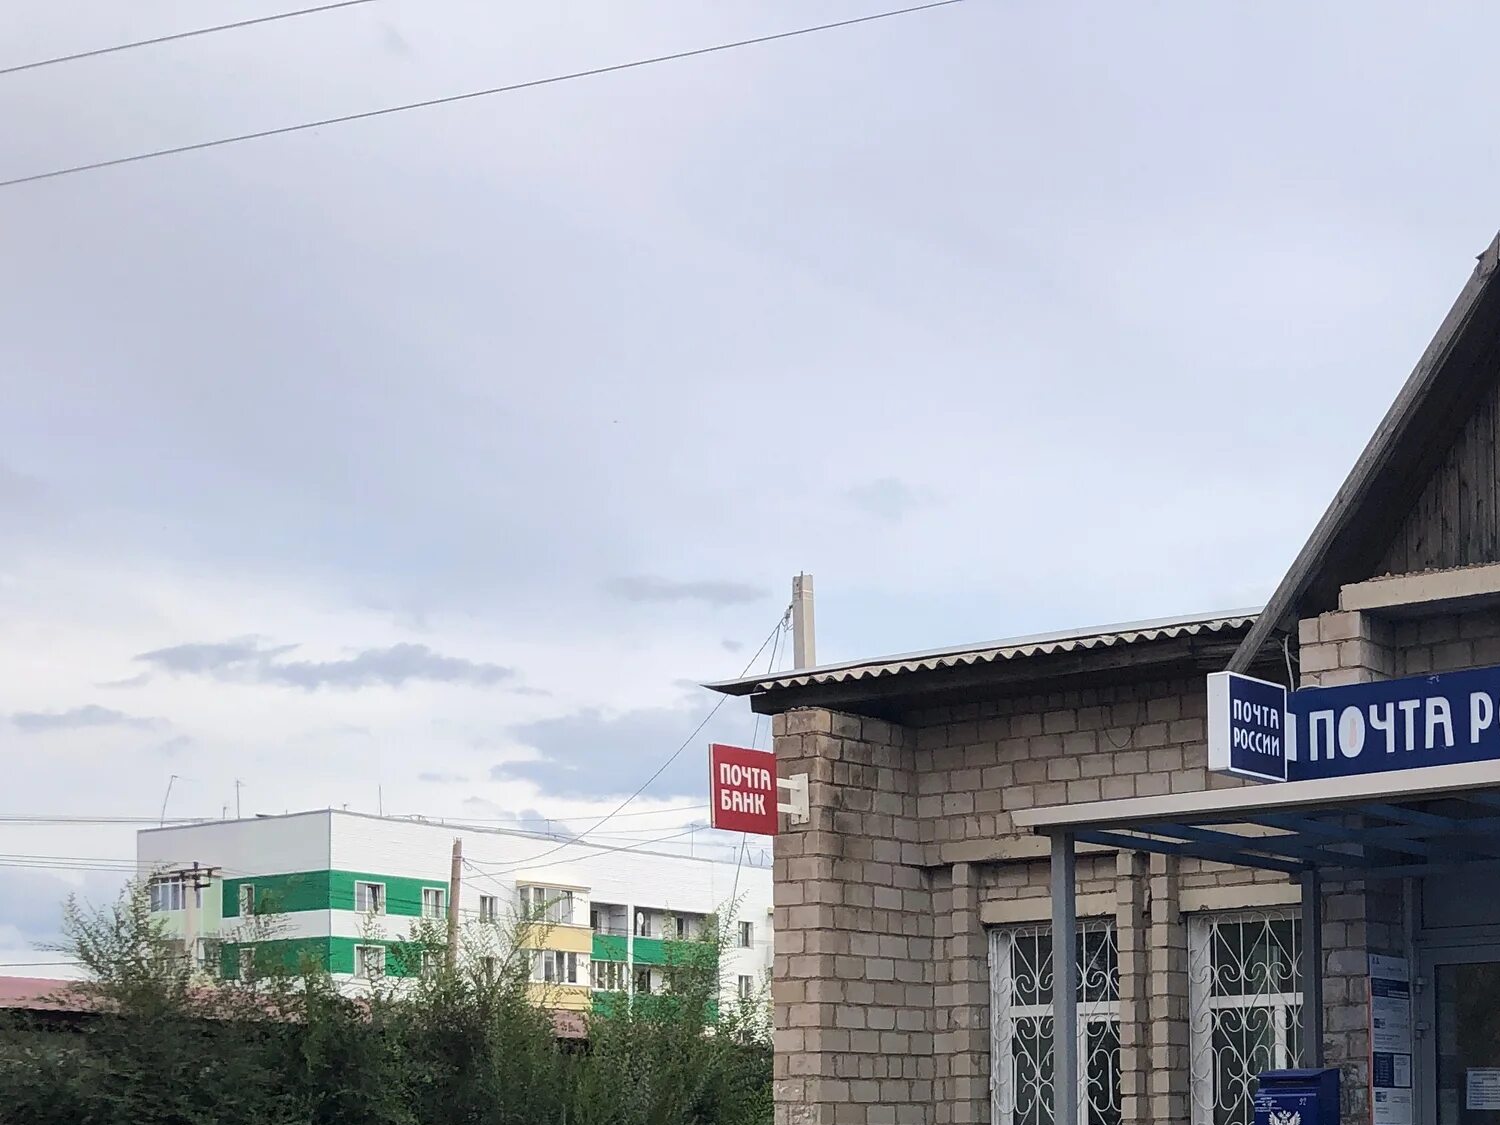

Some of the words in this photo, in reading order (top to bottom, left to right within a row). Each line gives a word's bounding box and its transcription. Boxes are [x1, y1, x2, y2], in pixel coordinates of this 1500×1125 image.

[1233, 698, 1280, 730] ПОЧТА
[1309, 696, 1455, 762] ПОЧТА
[1233, 726, 1280, 757] РОССИИ
[719, 762, 772, 791] ПОЧТА
[720, 788, 767, 816] БАНК
